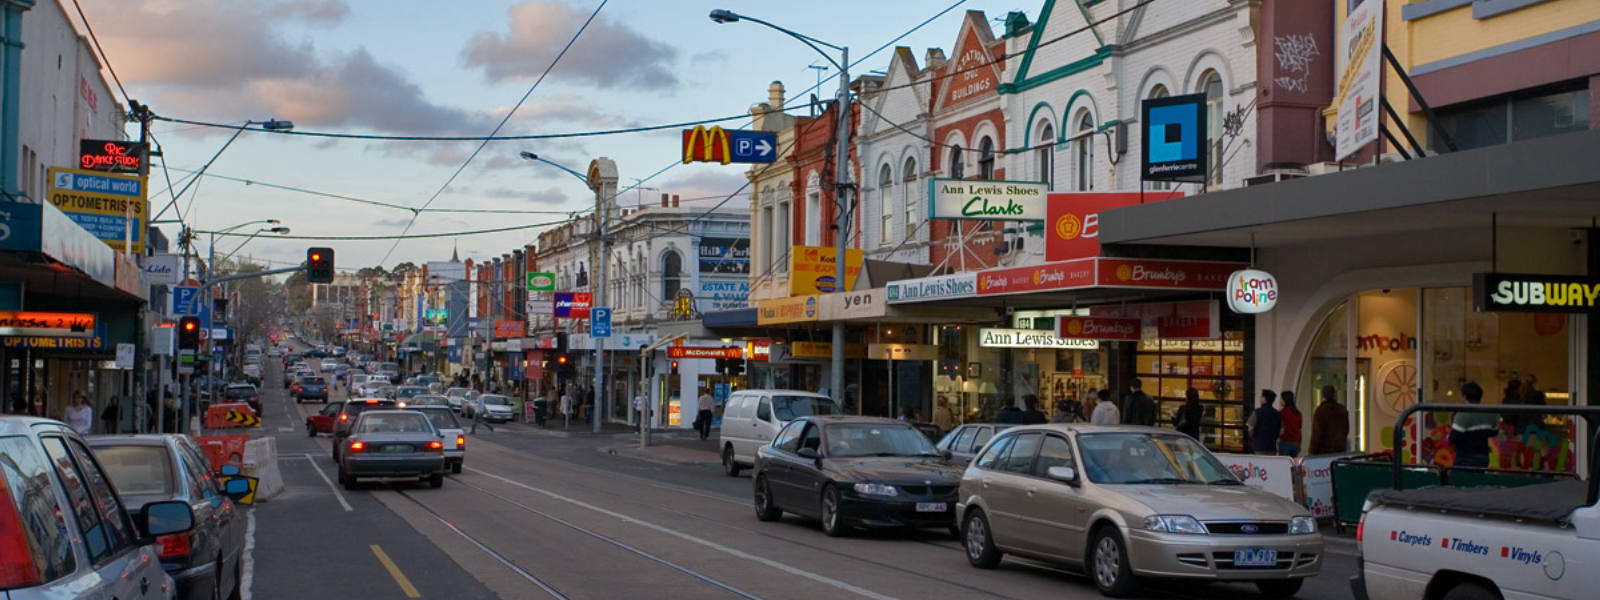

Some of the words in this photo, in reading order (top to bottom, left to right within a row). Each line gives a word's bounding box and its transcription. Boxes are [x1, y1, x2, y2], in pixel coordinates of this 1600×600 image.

[951, 78, 991, 101] BUILDINGS
[739, 140, 750, 154] P
[77, 176, 109, 190] optical
[111, 180, 137, 193] world
[942, 185, 964, 194] Ann
[969, 185, 1003, 195] Lewis
[1006, 185, 1039, 196] Shoes
[53, 193, 142, 214] OPTOMETRISTS
[961, 196, 1024, 216] Clarks
[820, 255, 836, 263] Kod
[145, 263, 172, 275] Lido
[702, 282, 737, 292] ESTATE
[902, 284, 918, 298] Ann
[919, 280, 945, 297] Lewis
[946, 278, 974, 294] Shoes
[1239, 275, 1274, 292] tram
[844, 294, 872, 310] yen
[1235, 289, 1277, 307] poline
[1490, 280, 1600, 307] SUBWAY
[596, 311, 606, 321] P
[4, 336, 102, 349] OPTOMETRISTS
[984, 331, 1012, 345] Ann
[1016, 331, 1053, 346] Lewis
[1398, 530, 1432, 547] Carpets
[1451, 538, 1489, 556] Timbers
[1511, 546, 1542, 565] Vinyls
